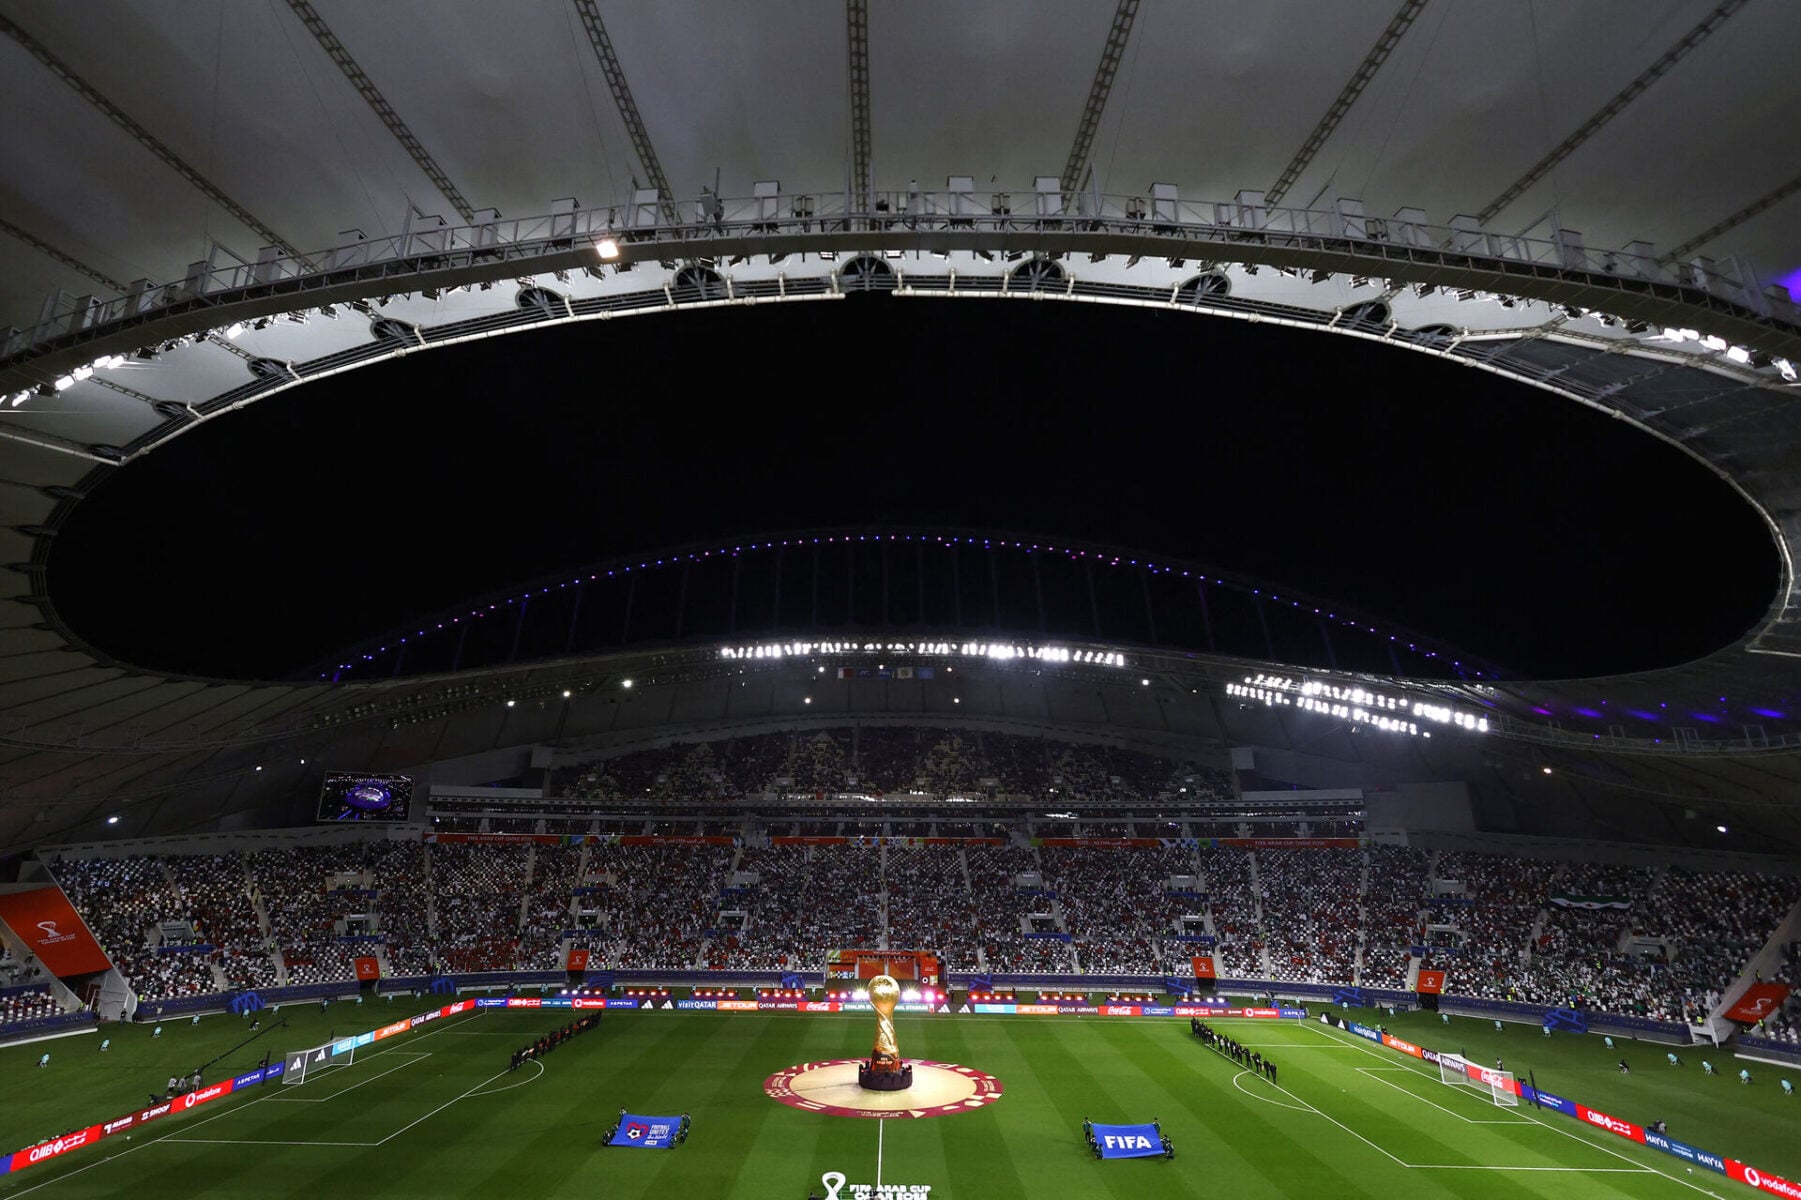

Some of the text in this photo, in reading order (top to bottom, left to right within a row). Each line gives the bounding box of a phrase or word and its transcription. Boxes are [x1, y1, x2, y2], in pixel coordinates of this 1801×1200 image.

[196, 1086, 222, 1102] vodafone
[1104, 1135, 1152, 1149] FIFA
[1645, 1133, 1669, 1149] HAYYA
[1697, 1152, 1725, 1170] HAYYA
[849, 1184, 932, 1193] FIFA ARAB CUP
[1760, 1177, 1801, 1199] vodafon
